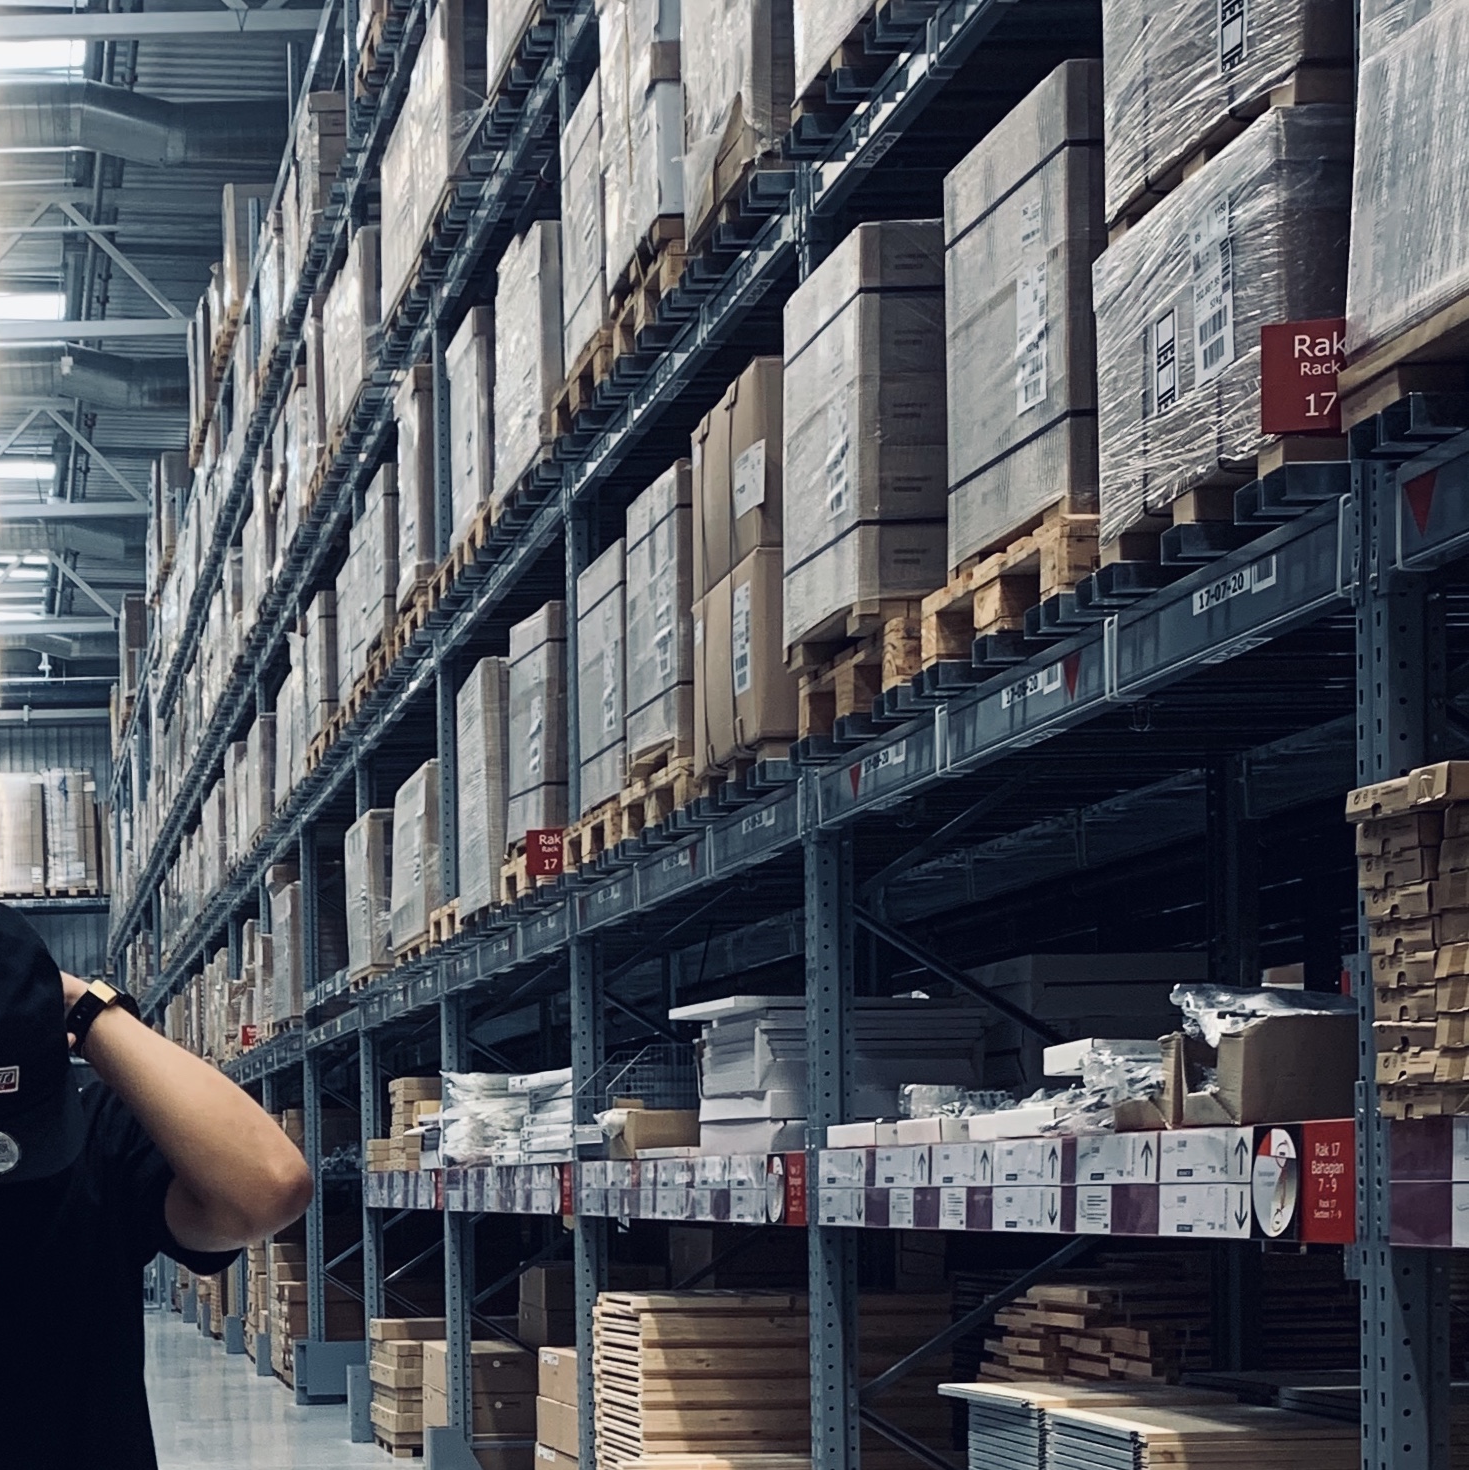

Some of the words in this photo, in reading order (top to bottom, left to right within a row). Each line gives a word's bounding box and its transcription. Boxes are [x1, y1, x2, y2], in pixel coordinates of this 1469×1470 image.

[1294, 331, 1346, 359] Rak
[1300, 359, 1342, 376] Rack
[1305, 391, 1338, 417] 17
[1199, 572, 1245, 610] 17-07-20
[538, 833, 562, 845] Rak
[543, 858, 558, 870] 17
[1315, 1142, 1330, 1157] Rak
[1332, 1142, 1341, 1157] 17
[1311, 1160, 1345, 1178] Bahagian
